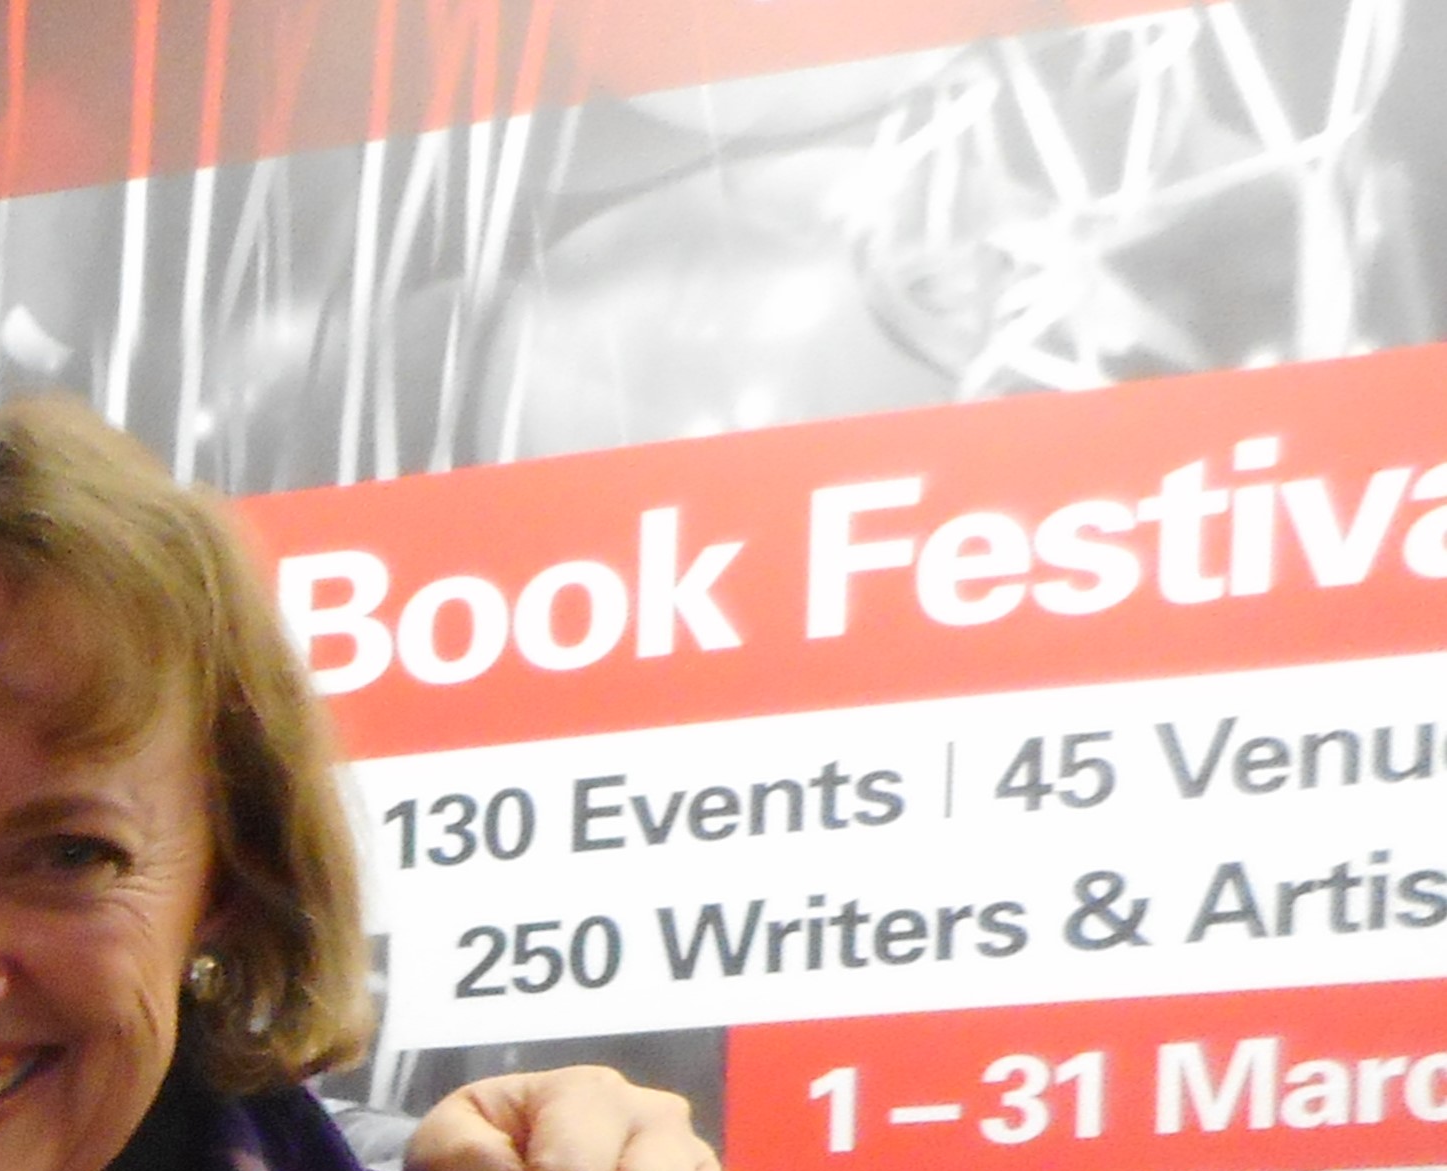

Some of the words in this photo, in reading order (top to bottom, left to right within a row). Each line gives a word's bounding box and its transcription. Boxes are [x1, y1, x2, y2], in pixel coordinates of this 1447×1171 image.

[277, 507, 746, 697] Book
[383, 786, 536, 870] 130
[571, 760, 906, 854] Events
[994, 730, 1116, 812] 45
[1153, 715, 1447, 800] Venu
[454, 914, 623, 999] 250
[656, 893, 1029, 982] Writers
[1062, 870, 1152, 951] &
[1184, 848, 1447, 944] Artis
